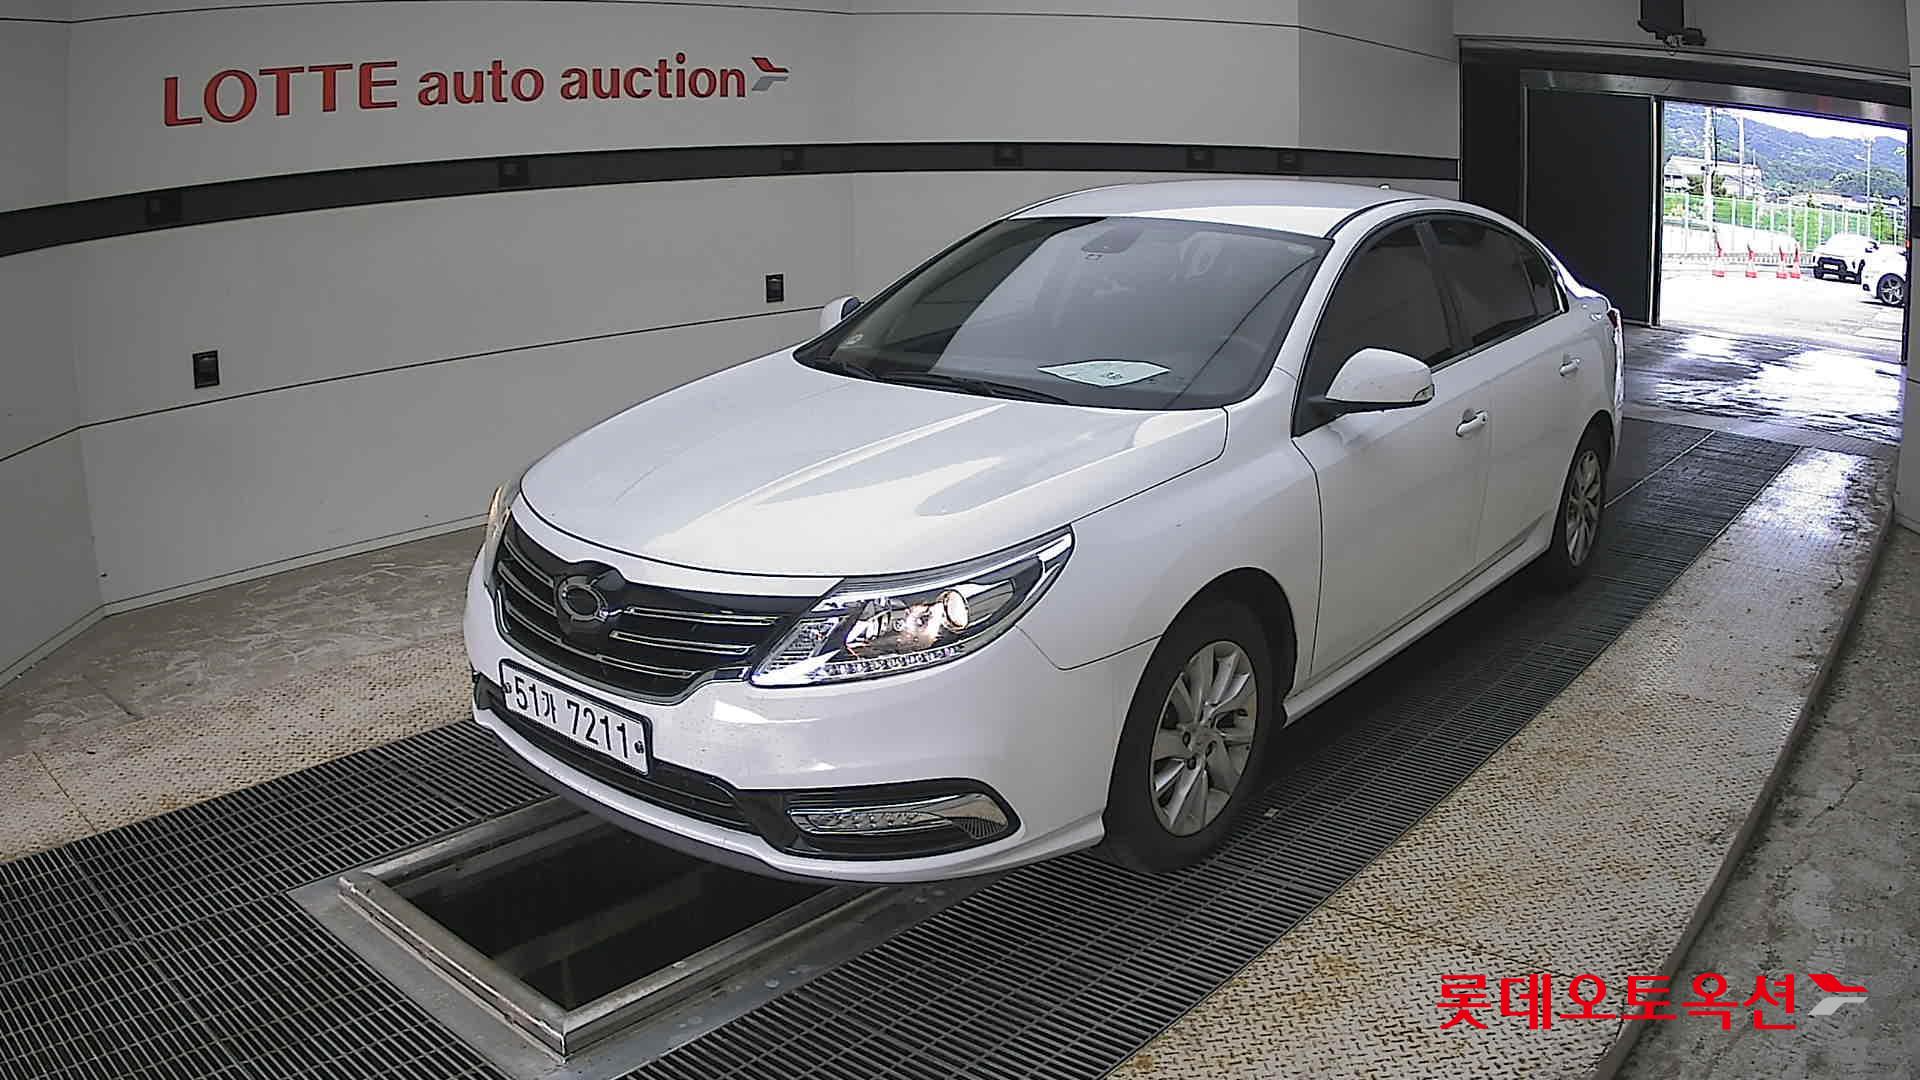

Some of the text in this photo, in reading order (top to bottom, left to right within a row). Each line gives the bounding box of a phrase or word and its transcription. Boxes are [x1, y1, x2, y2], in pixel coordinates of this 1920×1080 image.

[163, 51, 747, 127] LOTTE auto auction
[514, 676, 629, 759] 51가 7211
